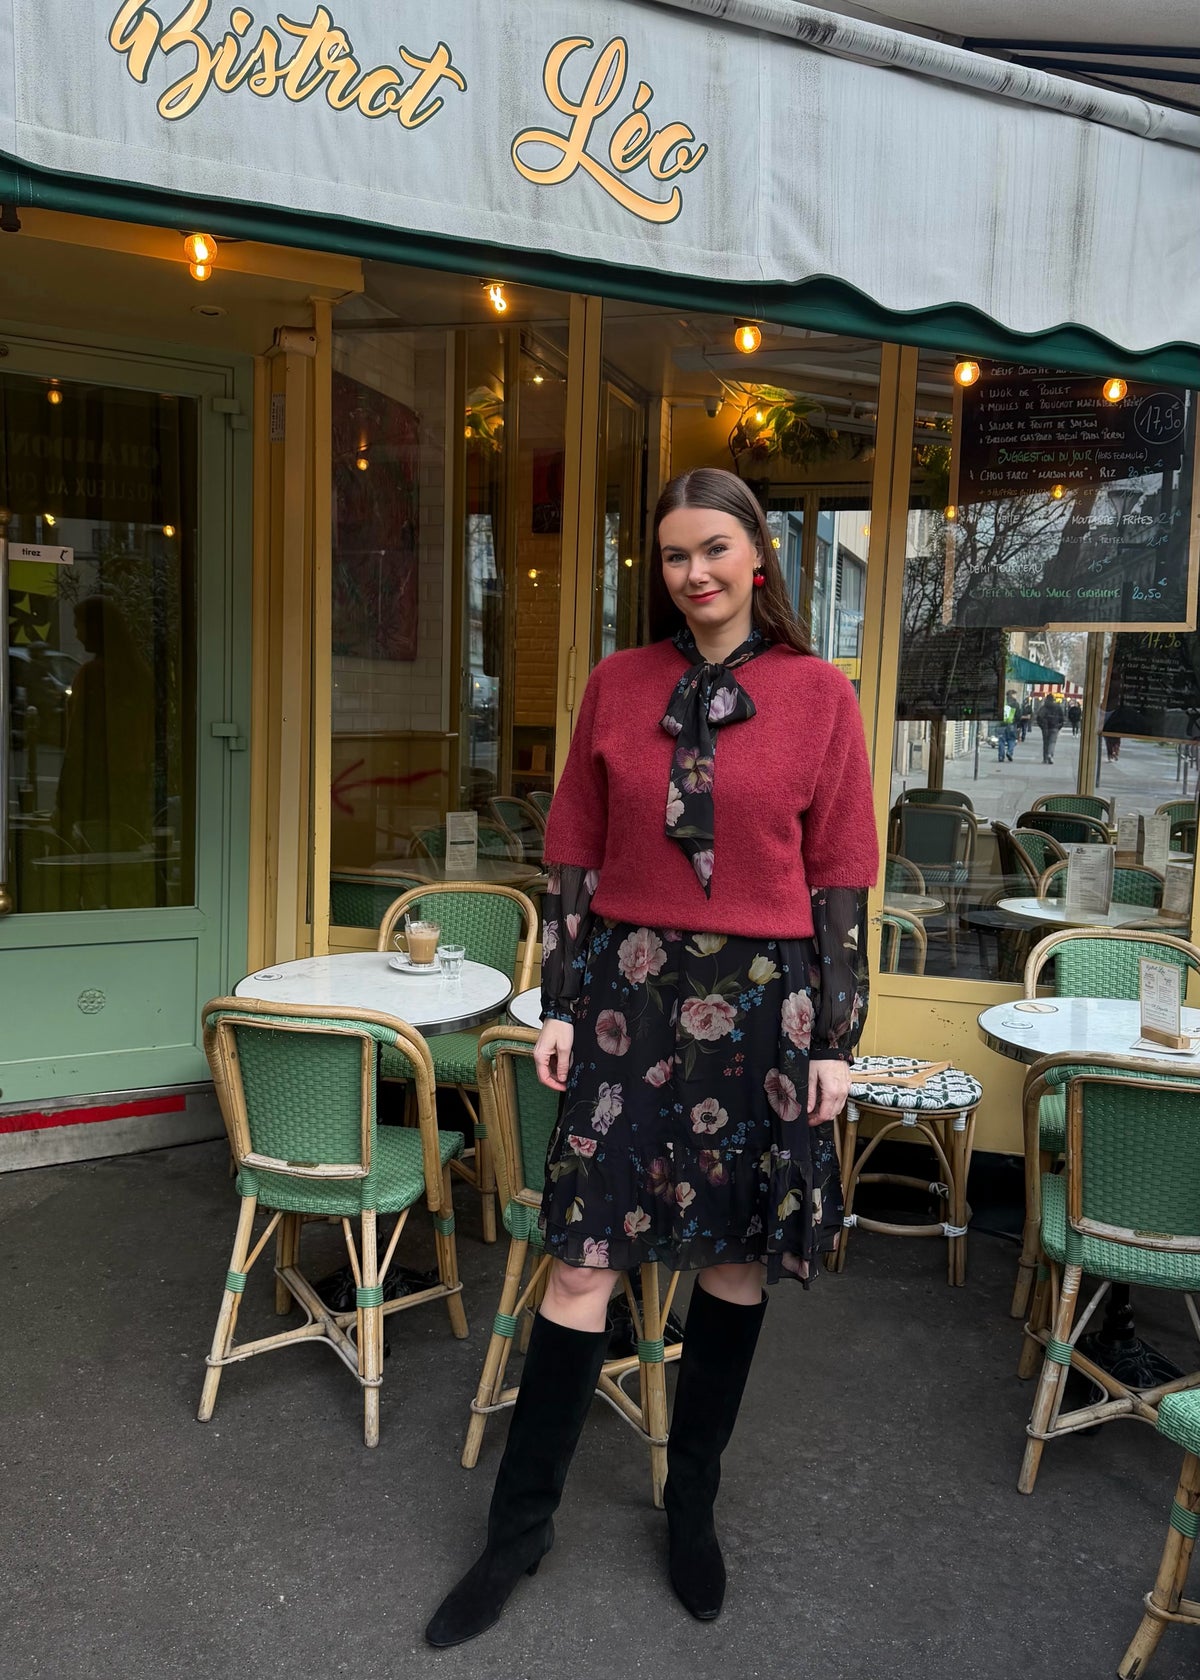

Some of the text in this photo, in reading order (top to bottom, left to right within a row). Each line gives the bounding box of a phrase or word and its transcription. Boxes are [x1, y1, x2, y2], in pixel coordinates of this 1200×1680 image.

[106, 0, 709, 224] Bistrot Léo
[989, 383, 1072, 399] WOK DE POULET
[988, 401, 1019, 411] MOULES
[1024, 401, 1035, 409] DE
[1039, 399, 1074, 409] BOUCHOT
[988, 418, 1098, 431] SALADE DE FRUITS DE SAISON
[985, 435, 1018, 444] BRIOCHE
[1080, 431, 1100, 441] PAIN
[1101, 427, 1126, 440] PERDU
[1059, 450, 1069, 462] DU
[1068, 449, 1093, 467] JOUR
[1113, 448, 1148, 462] FORMULE)
[979, 469, 1004, 481] CHOU
[1006, 470, 1029, 480] FARCI
[1099, 466, 1117, 478] RIZ
[22, 547, 41, 557] tirez
[995, 563, 1043, 574] TOURTEAU
[1020, 584, 1041, 598] VEAU
[1046, 587, 1072, 598] SAUCE
